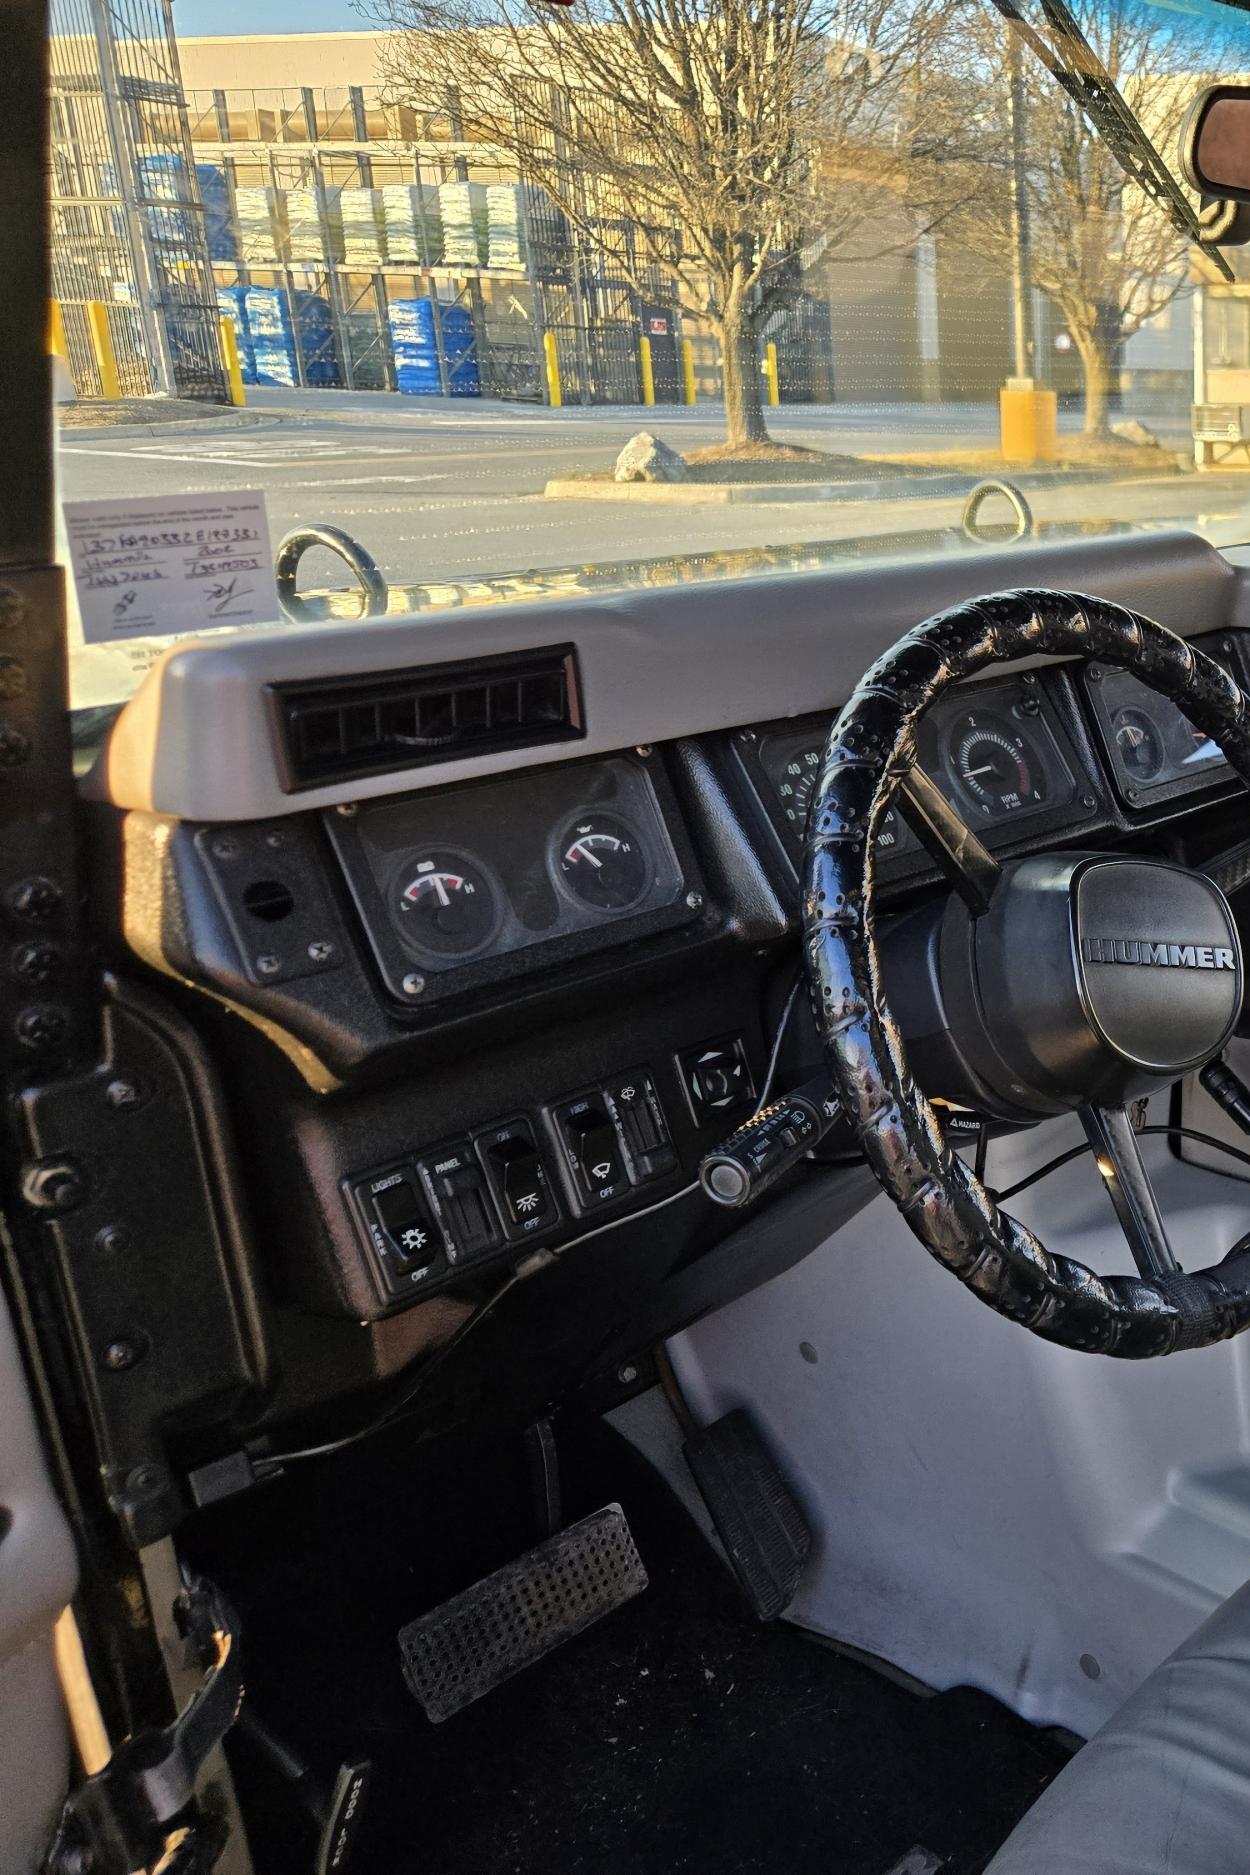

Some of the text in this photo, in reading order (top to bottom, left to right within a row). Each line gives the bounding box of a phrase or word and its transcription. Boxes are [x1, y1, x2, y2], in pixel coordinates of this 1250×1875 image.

[968, 716, 977, 727] 2
[1015, 738, 1023, 748] 3
[804, 752, 819, 765] 50
[787, 763, 801, 776] 40
[1000, 792, 1019, 804] RPM
[1033, 790, 1041, 800] 4
[877, 833, 895, 847] 100
[561, 843, 631, 871] L H
[400, 883, 475, 911] L H
[1084, 938, 1236, 970] HUMMER
[958, 1121, 981, 1129] HAZARD
[434, 1157, 462, 1175] PANEL
[568, 1149, 579, 1170] LOW
[371, 1173, 403, 1194] LIGHTS
[600, 1186, 615, 1198] OFF
[524, 1216, 541, 1230] OFF
[371, 1224, 388, 1257] PARK
[411, 1266, 430, 1282] OFF
[344, 1778, 363, 1819] HOOD
